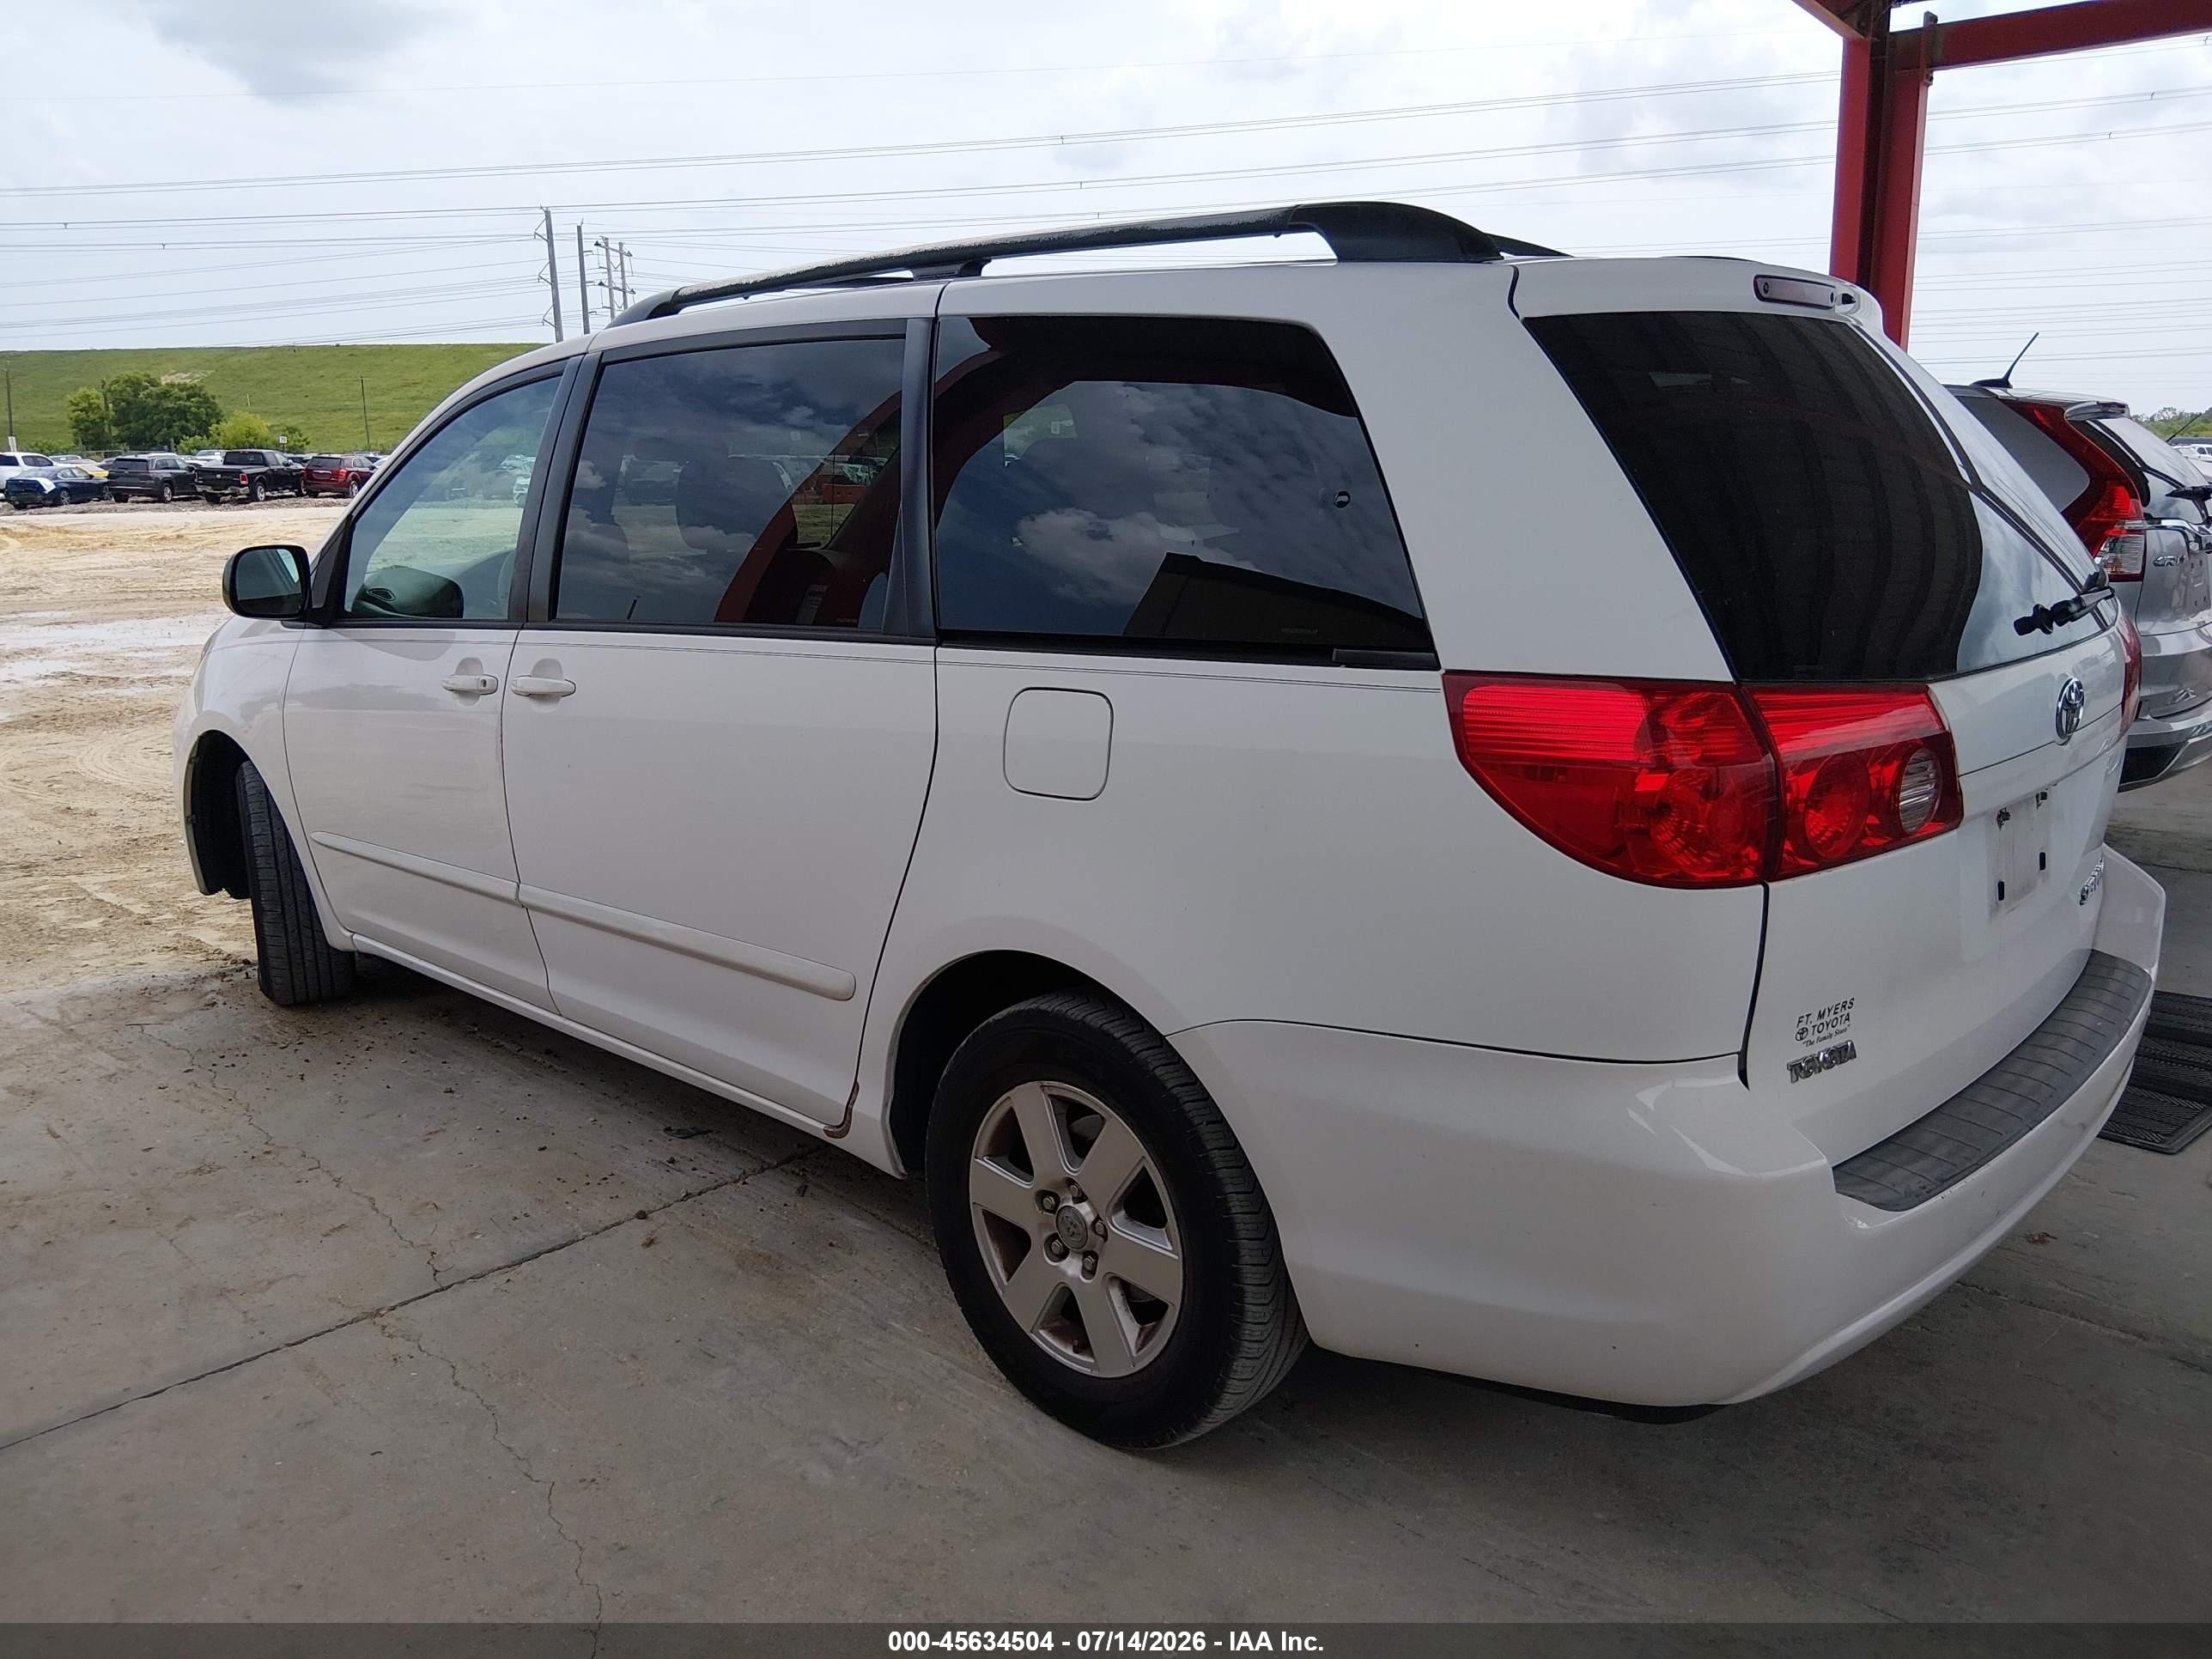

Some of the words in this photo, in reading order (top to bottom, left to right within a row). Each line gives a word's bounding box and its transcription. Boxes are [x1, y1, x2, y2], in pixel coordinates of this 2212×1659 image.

[1796, 1012, 1813, 1028] FT.
[1817, 997, 1855, 1021] MYERS
[1812, 1012, 1850, 1036] TOYOTA
[1787, 1040, 1856, 1084] TOYOTA
